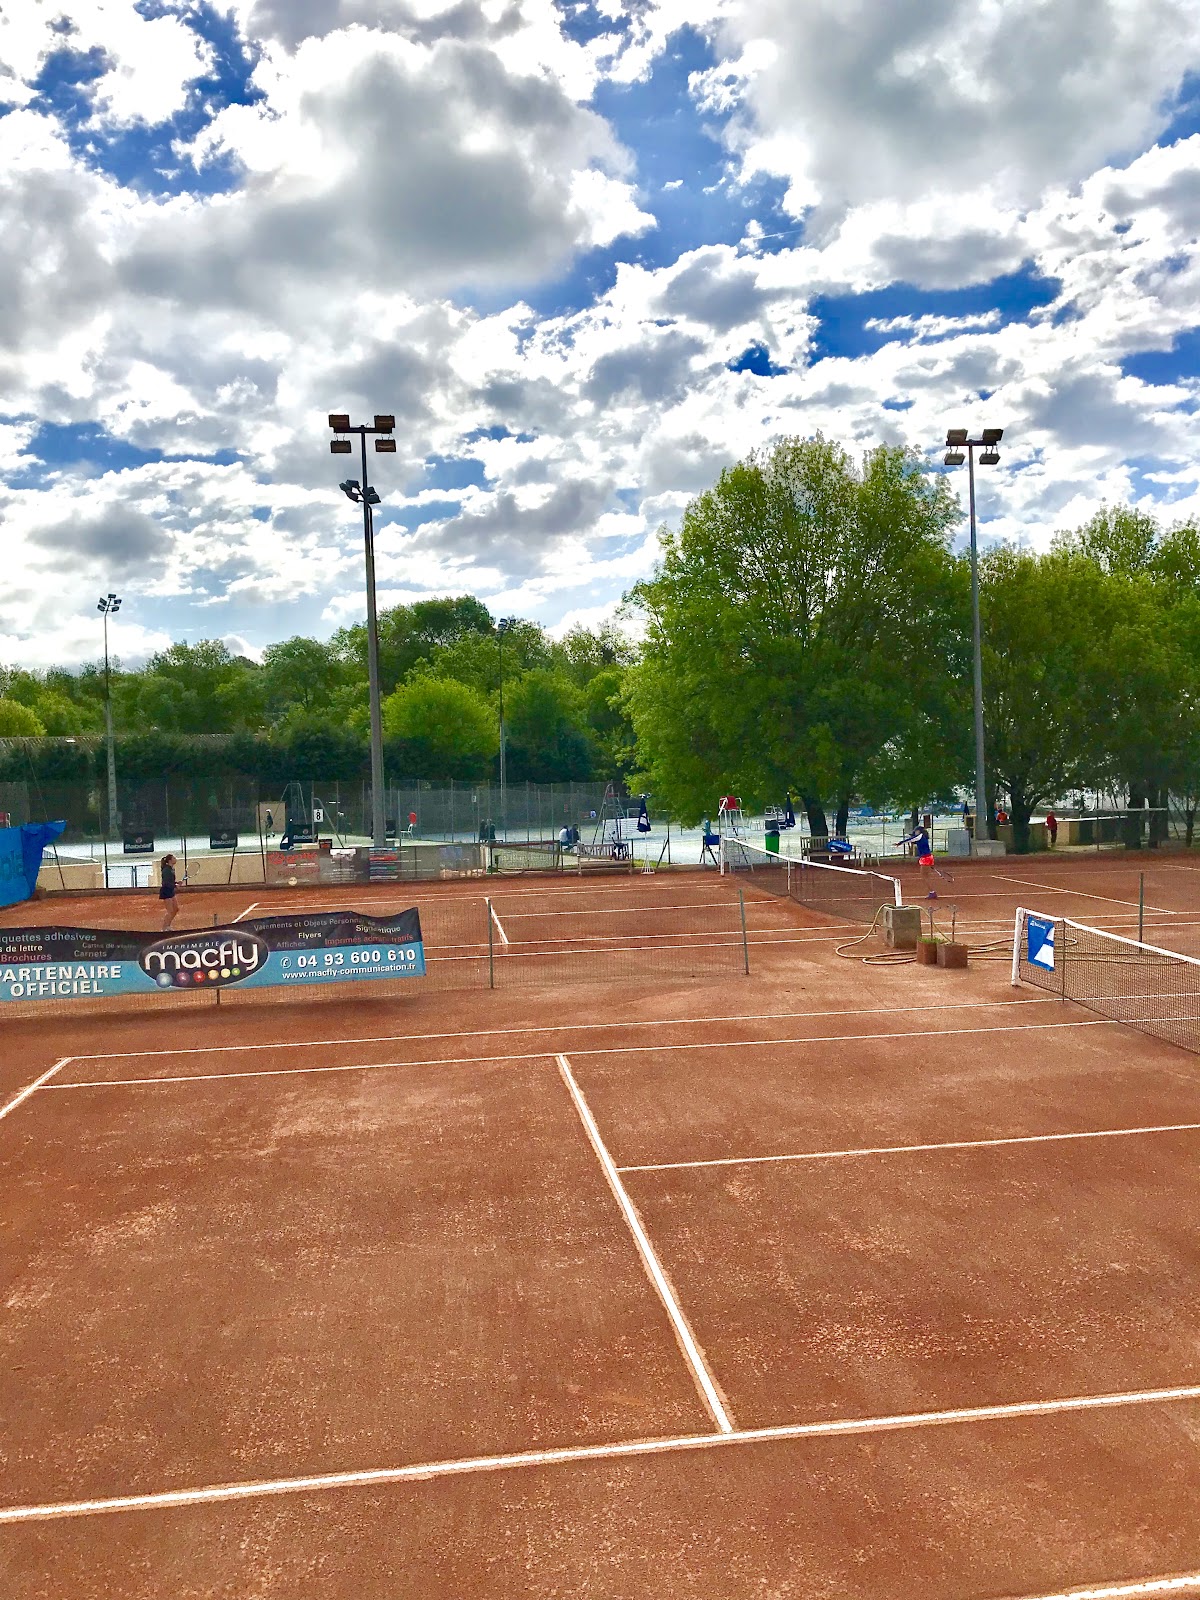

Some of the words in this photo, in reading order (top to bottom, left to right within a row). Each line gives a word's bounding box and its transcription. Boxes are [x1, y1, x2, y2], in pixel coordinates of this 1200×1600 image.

[303, 919, 327, 928] Objets
[0, 934, 42, 945] quettes
[44, 931, 98, 942] adhésives
[298, 932, 322, 940] Flyers
[5, 945, 17, 953] de
[19, 944, 43, 952] lettre
[162, 940, 220, 951] IMPRIMERIE
[276, 941, 307, 949] Affiches
[0, 953, 52, 963] Brochures
[74, 949, 107, 958] Carnets
[144, 939, 259, 971] macfly
[297, 955, 318, 968] 04
[324, 952, 344, 966] 93
[350, 950, 381, 964] 600
[387, 949, 415, 961] 610
[282, 963, 416, 979] www.macfly-communication.fr
[10, 980, 104, 997] OFFICIEL
